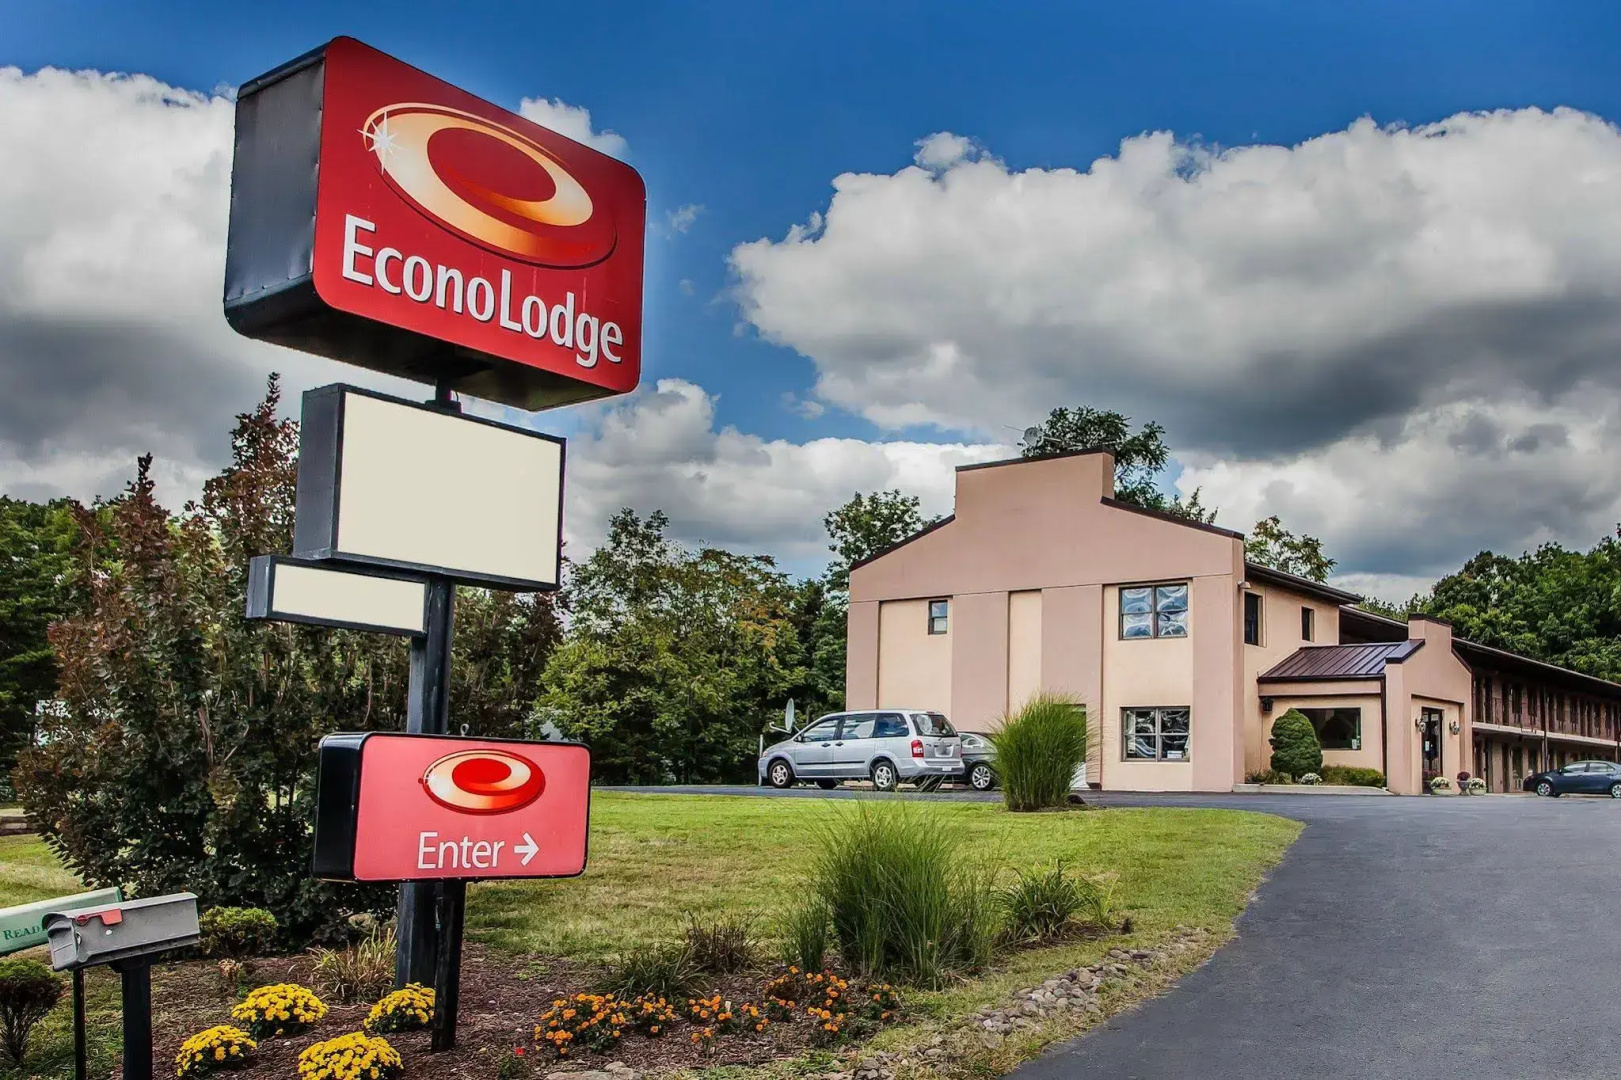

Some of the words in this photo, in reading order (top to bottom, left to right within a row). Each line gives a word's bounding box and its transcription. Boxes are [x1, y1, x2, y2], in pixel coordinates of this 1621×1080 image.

[341, 213, 623, 368] EconoLodge
[417, 831, 505, 869] Enter
[2, 924, 44, 940] READ
